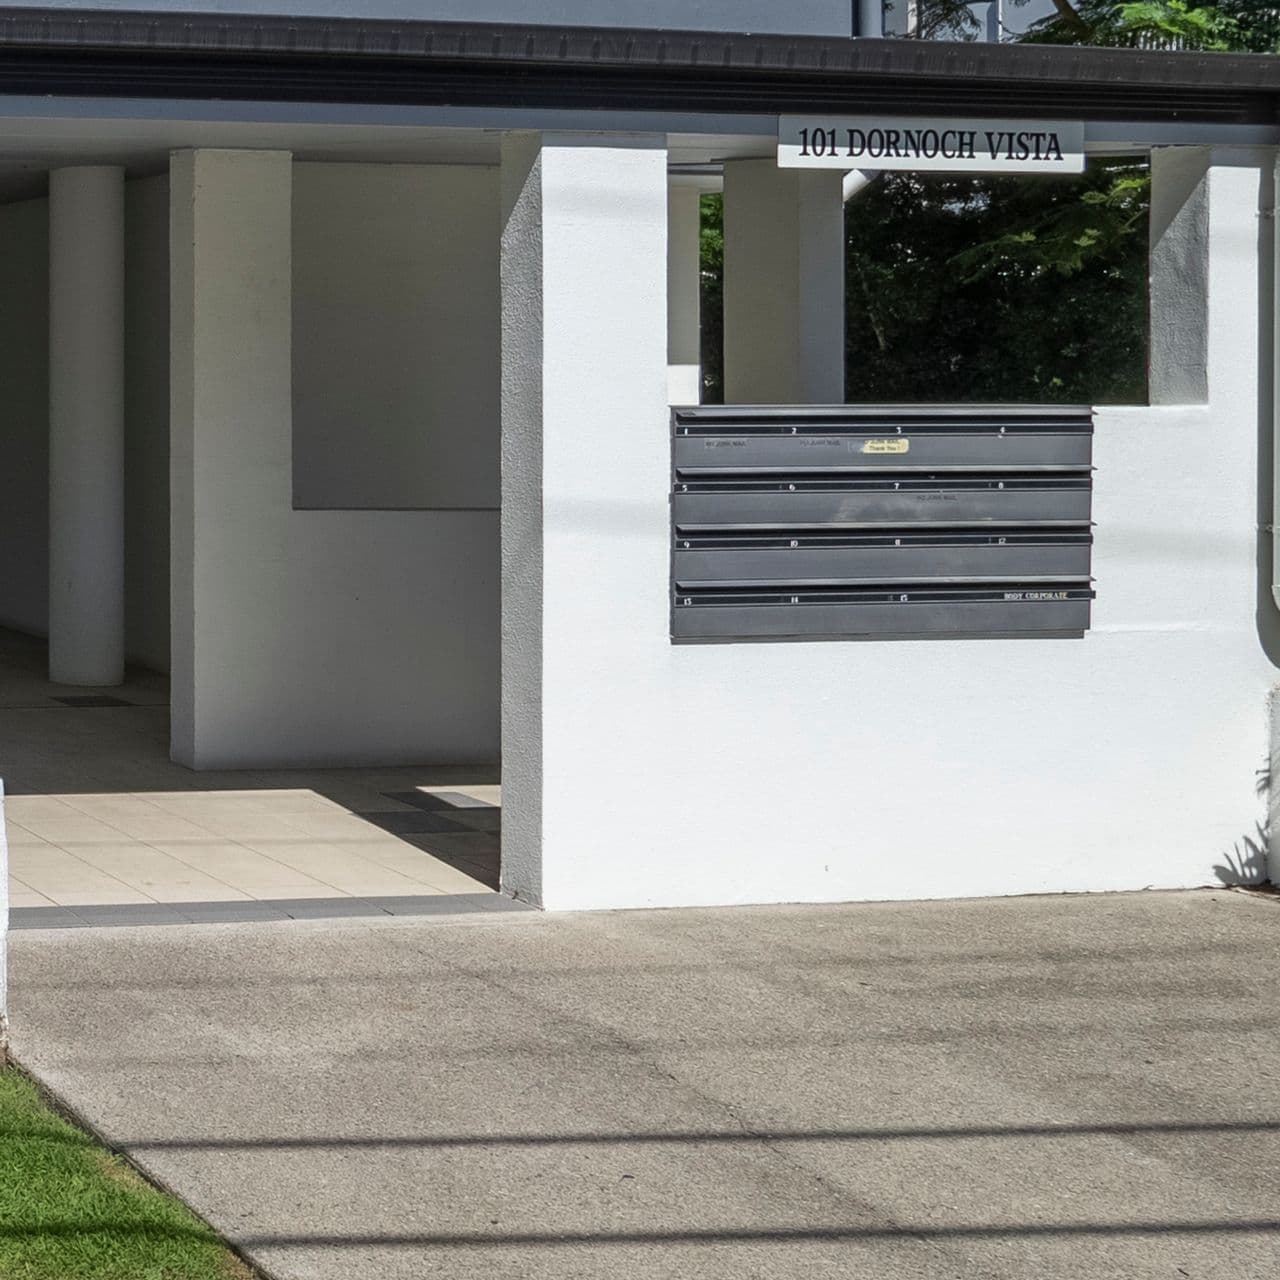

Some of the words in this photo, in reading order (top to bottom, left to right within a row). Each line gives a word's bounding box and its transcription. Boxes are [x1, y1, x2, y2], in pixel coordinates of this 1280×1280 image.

[798, 127, 838, 157] 101
[846, 128, 977, 159] DORNOCH
[985, 131, 1064, 161] VISTA
[683, 540, 690, 548] 9
[1003, 592, 1023, 601] BODY
[1025, 591, 1069, 600] CORPORATE
